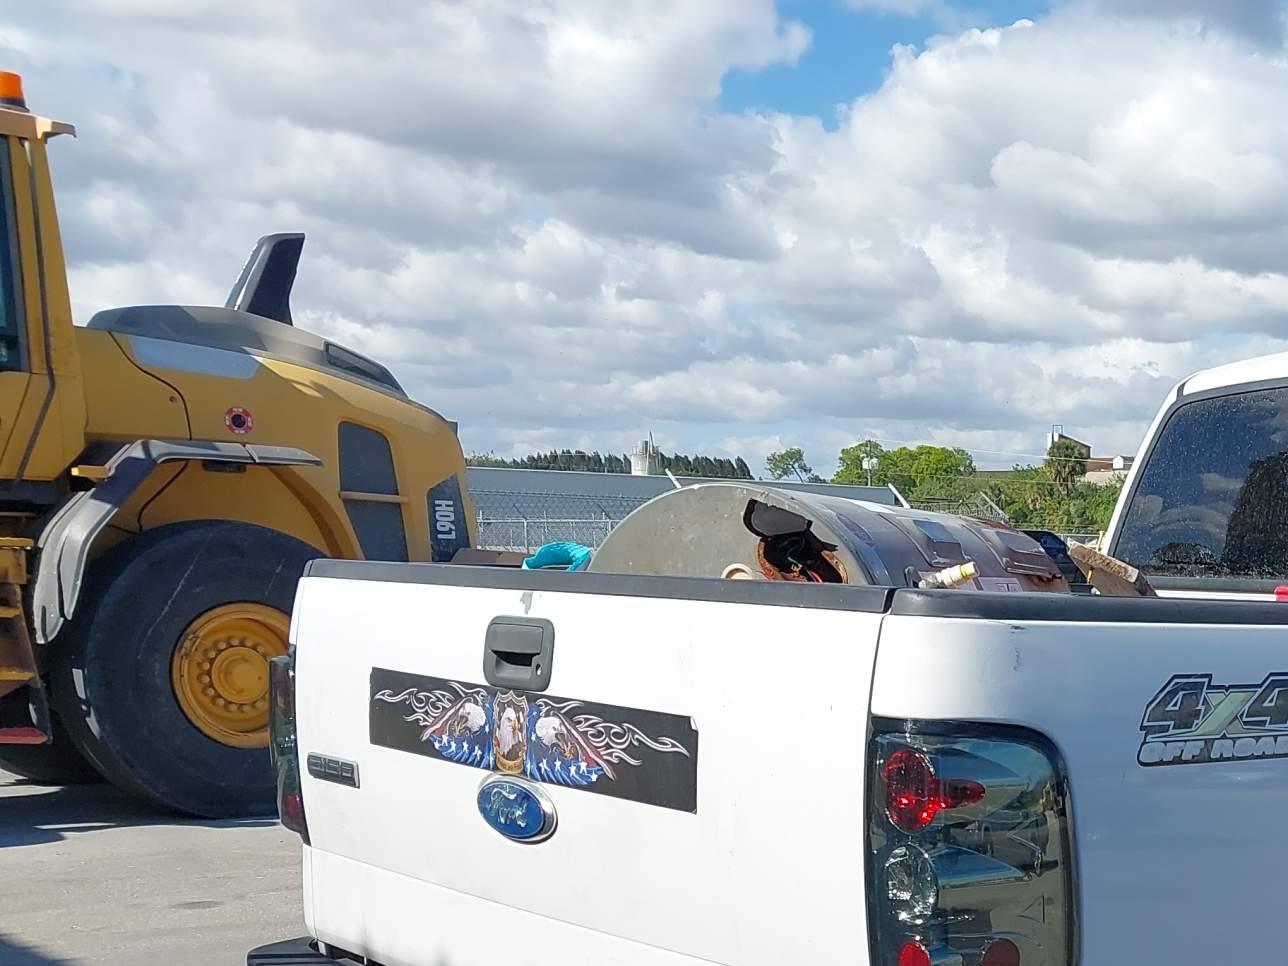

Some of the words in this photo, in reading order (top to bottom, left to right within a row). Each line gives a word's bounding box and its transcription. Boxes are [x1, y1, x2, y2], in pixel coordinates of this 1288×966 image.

[434, 499, 457, 540] L90H
[1139, 740, 1205, 763] OFF
[488, 786, 528, 828] Ford
